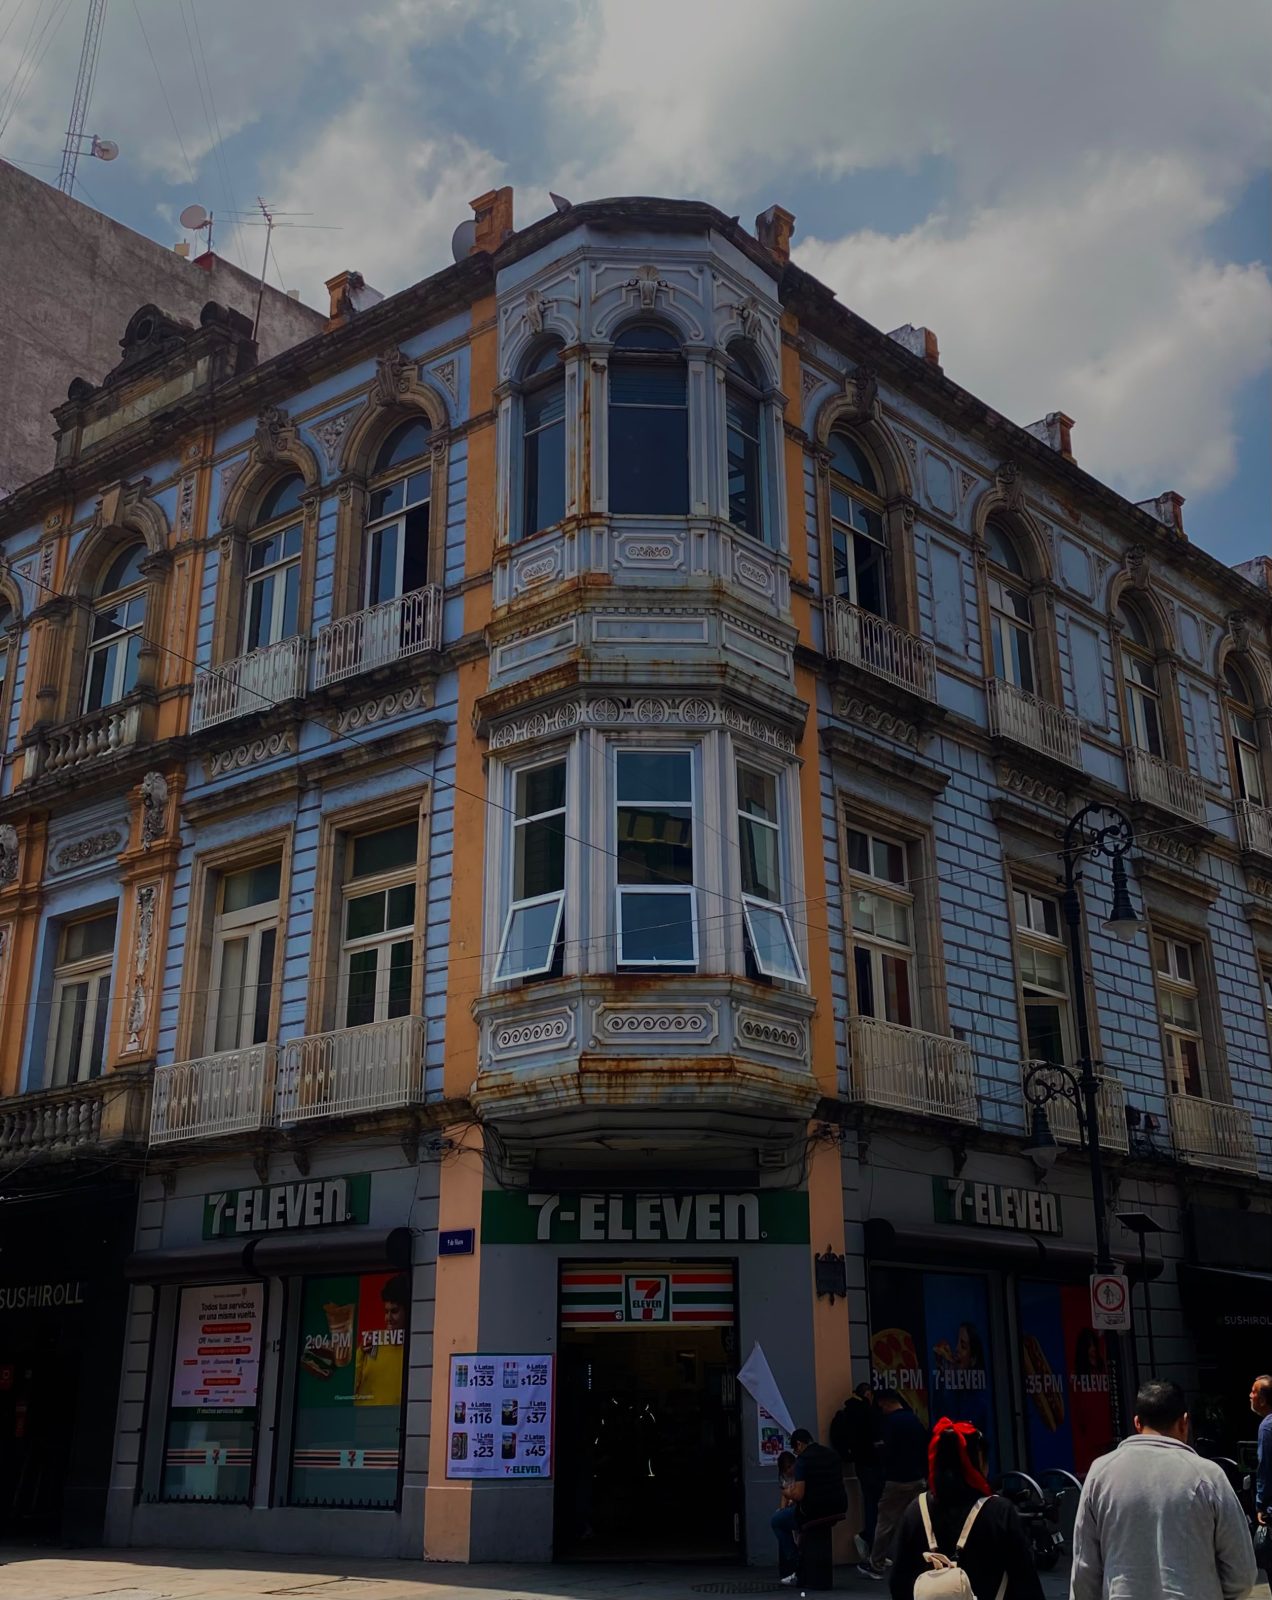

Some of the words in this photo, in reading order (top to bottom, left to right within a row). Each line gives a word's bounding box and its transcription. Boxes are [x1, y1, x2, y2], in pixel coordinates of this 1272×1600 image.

[0, 1282, 84, 1309] SUSHIROLL
[201, 1302, 218, 1311] Todos
[228, 1300, 255, 1310] servicios
[218, 1310, 236, 1319] misma
[304, 1333, 329, 1350] 2:04
[330, 1330, 351, 1348] PM
[469, 1375, 494, 1387] $133
[521, 1374, 547, 1386] $125
[871, 1369, 898, 1390] 3:15
[900, 1368, 923, 1390] PM
[1043, 1373, 1064, 1392] PM
[469, 1413, 492, 1424] $116
[526, 1412, 547, 1423] $37
[473, 1446, 494, 1458] $23
[525, 1445, 546, 1457] $45
